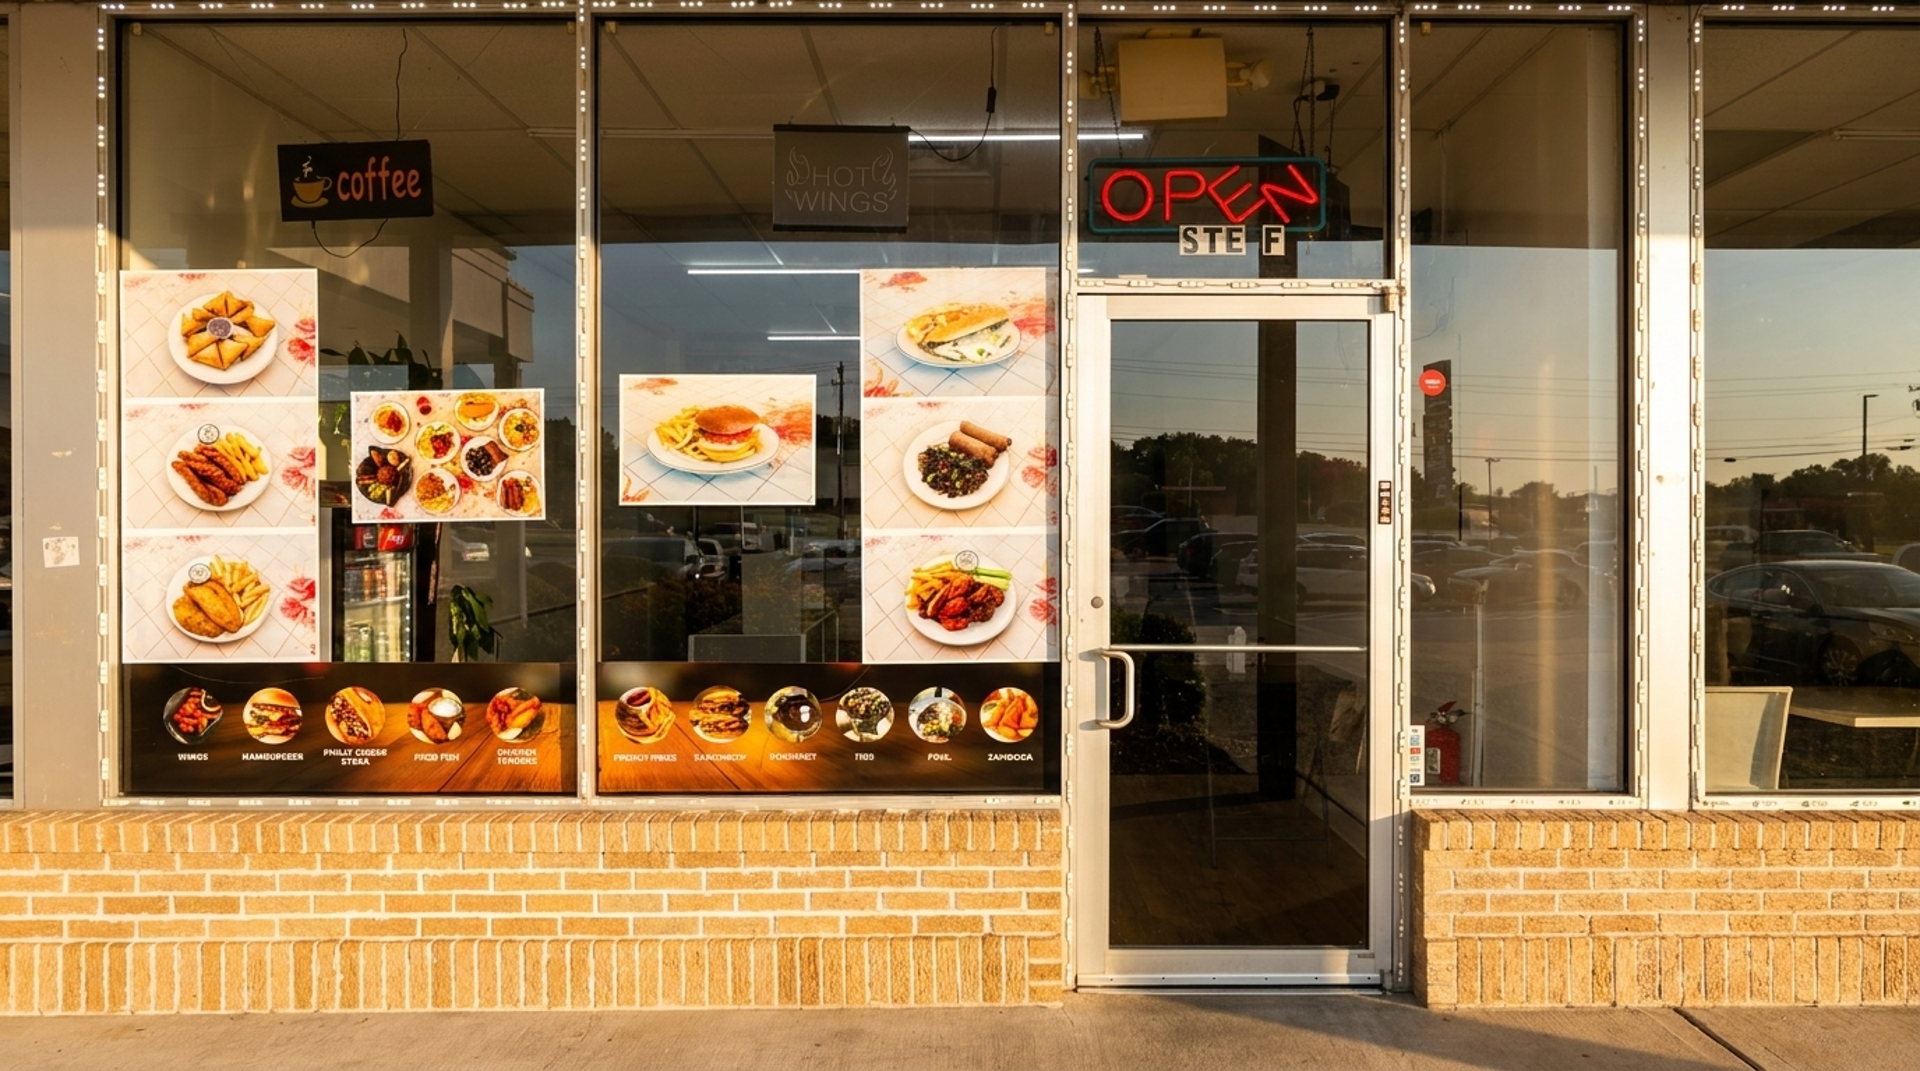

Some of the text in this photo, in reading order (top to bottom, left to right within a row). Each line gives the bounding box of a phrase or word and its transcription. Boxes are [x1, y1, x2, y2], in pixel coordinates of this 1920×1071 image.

[336, 155, 422, 203] coffee
[812, 166, 871, 188] HOT
[793, 190, 889, 213] WINGS
[1101, 164, 1319, 224] OPEN
[1182, 226, 1282, 254] STE F
